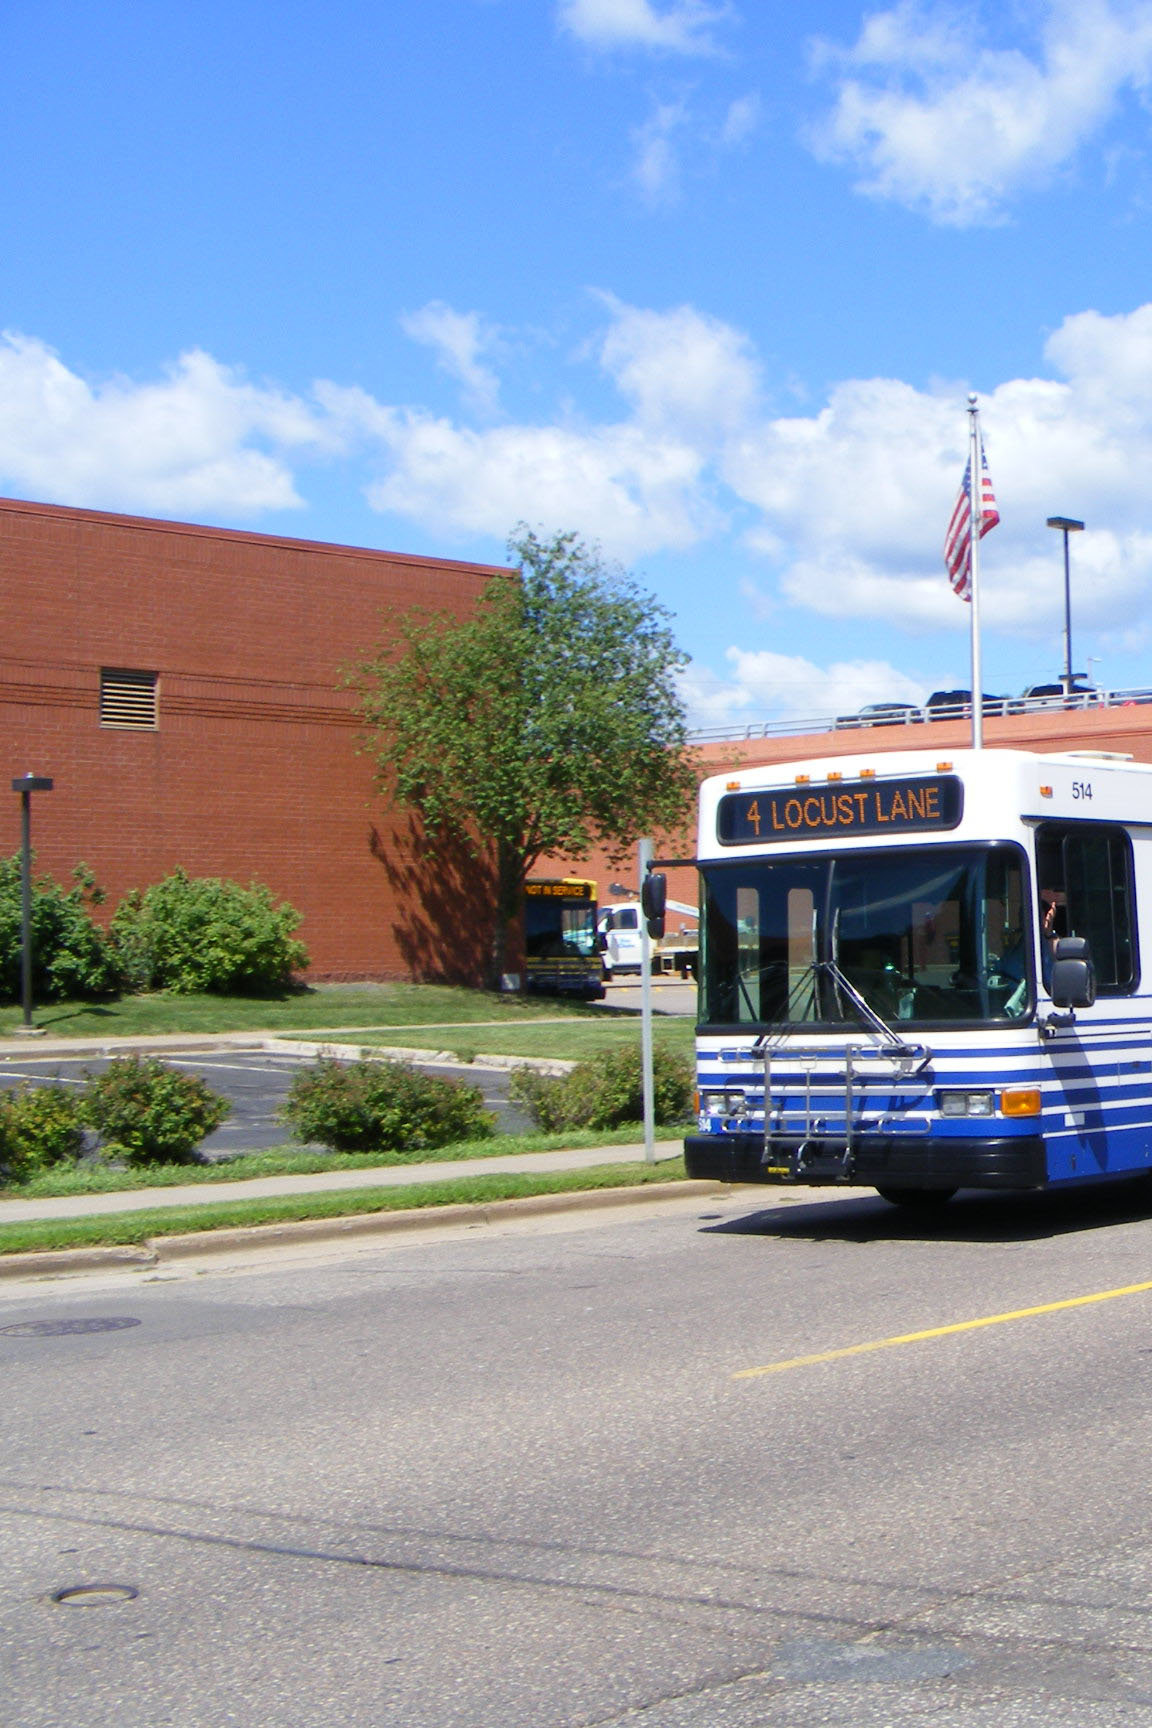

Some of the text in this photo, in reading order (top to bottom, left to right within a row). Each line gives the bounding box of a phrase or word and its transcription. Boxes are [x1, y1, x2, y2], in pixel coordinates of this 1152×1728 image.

[1072, 781, 1093, 800] 514
[746, 787, 941, 835] 4 LOCUST LANE
